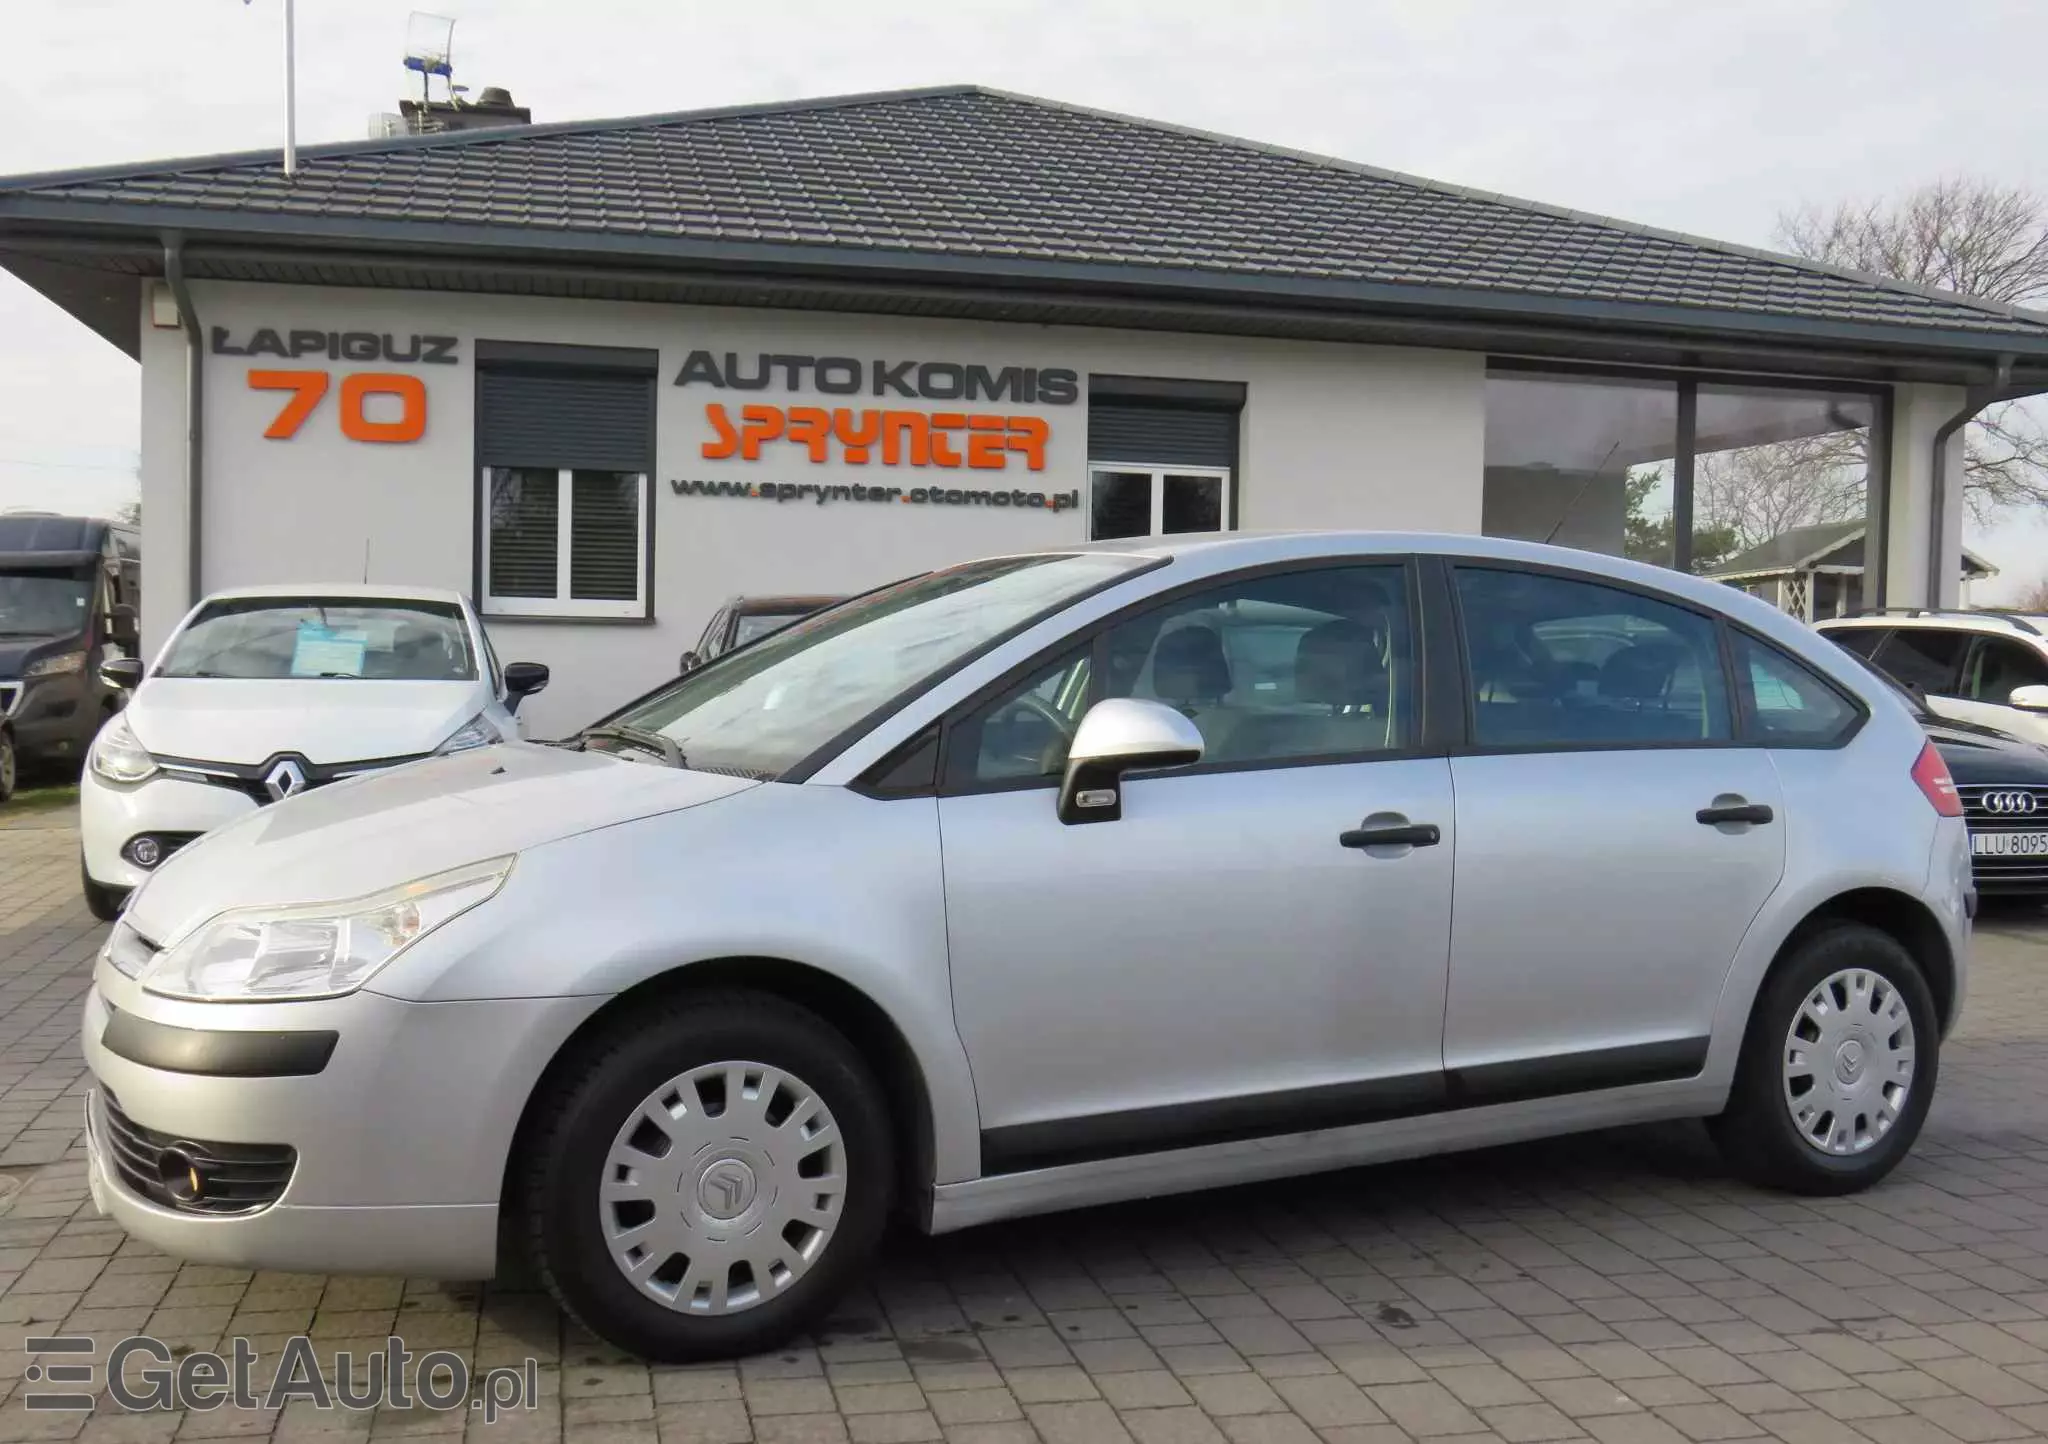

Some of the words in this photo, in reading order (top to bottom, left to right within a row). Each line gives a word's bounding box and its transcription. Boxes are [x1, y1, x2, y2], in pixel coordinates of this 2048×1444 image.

[211, 326, 459, 364] ŁAPIGUZ
[673, 350, 861, 395] AUTO
[873, 360, 1079, 405] KOMIS
[247, 369, 427, 443] 70
[701, 403, 1051, 472] SPRYNTER
[671, 478, 1079, 513] www.sprynter.otomoto.pl
[1974, 835, 2006, 854] LLU
